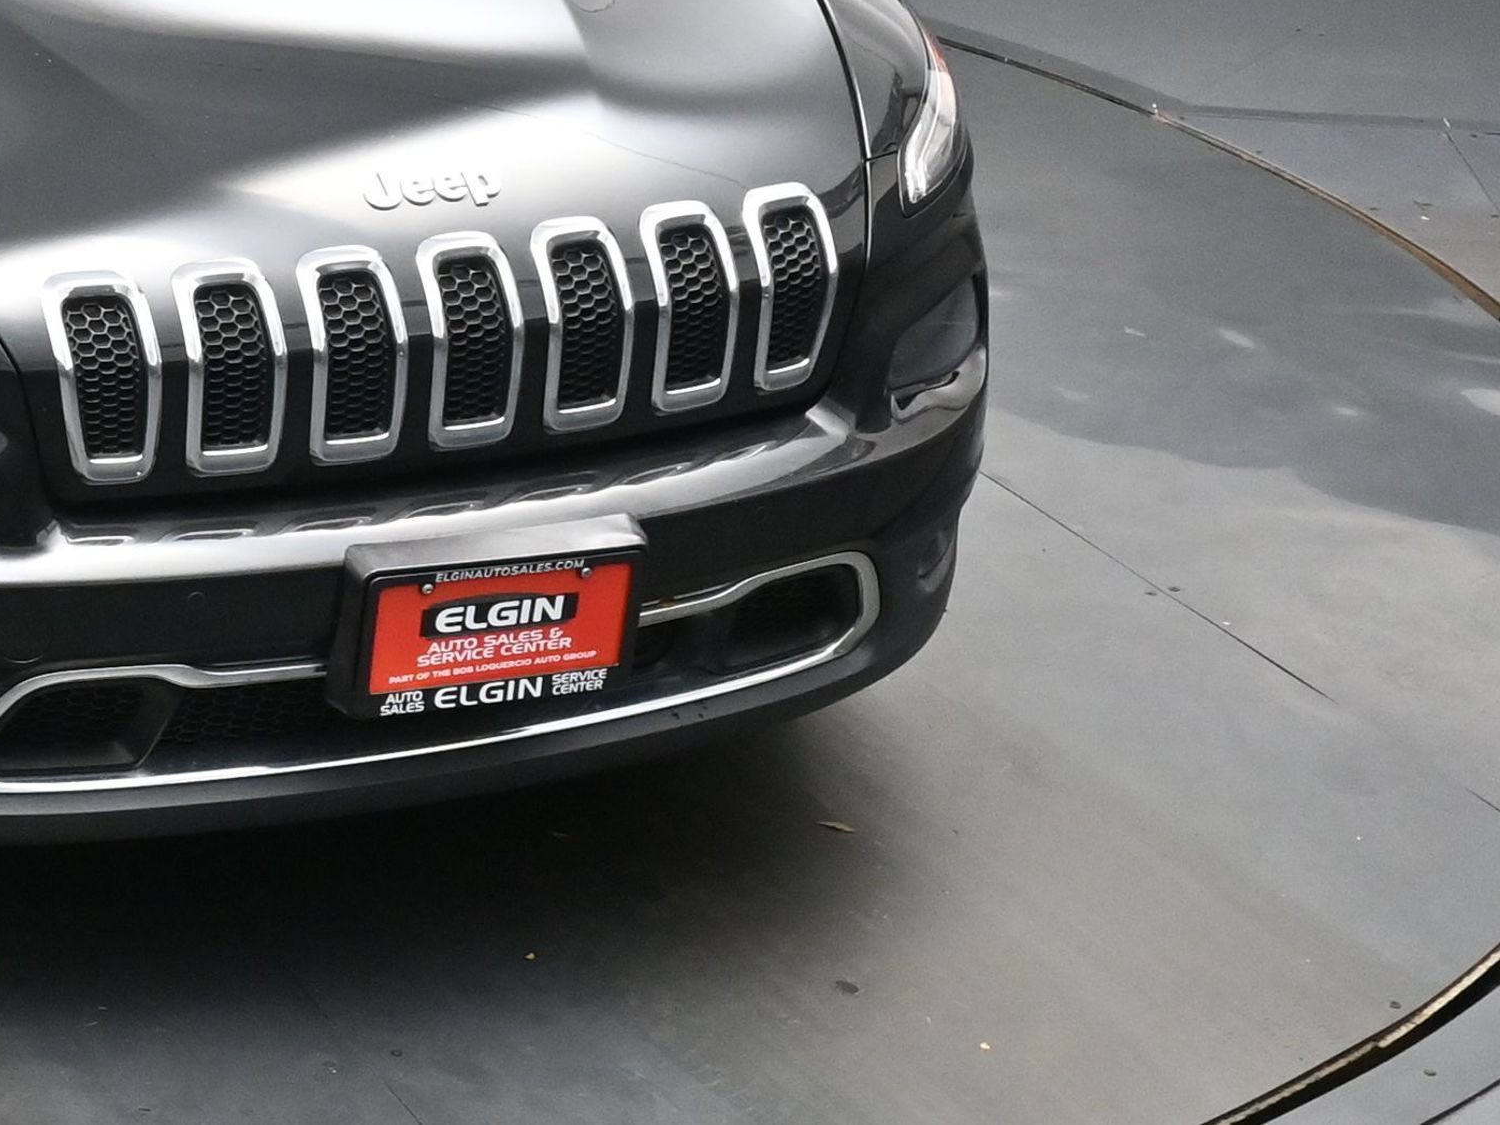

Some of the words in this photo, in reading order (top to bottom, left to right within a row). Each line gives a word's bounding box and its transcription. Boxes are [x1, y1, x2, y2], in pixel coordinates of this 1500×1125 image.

[363, 169, 501, 211] Jeep
[435, 558, 585, 583] ELGINAUTOSALES.COM
[435, 595, 565, 634] ELGIN
[417, 647, 495, 668] SERVICE
[500, 637, 572, 656] CENTER
[427, 637, 478, 654] AUTO
[483, 629, 543, 648] SALES
[549, 627, 564, 639] &
[388, 674, 415, 684] PART
[416, 672, 430, 681] OF
[432, 669, 451, 679] THE
[453, 666, 474, 676] BOB
[534, 654, 561, 665] AUTO
[563, 650, 597, 661] GROUP
[552, 668, 608, 686] SERVICE
[385, 690, 423, 705] AUTO
[434, 677, 543, 709] ELGIN
[552, 680, 604, 696] CENTER
[380, 701, 425, 717] SALES
